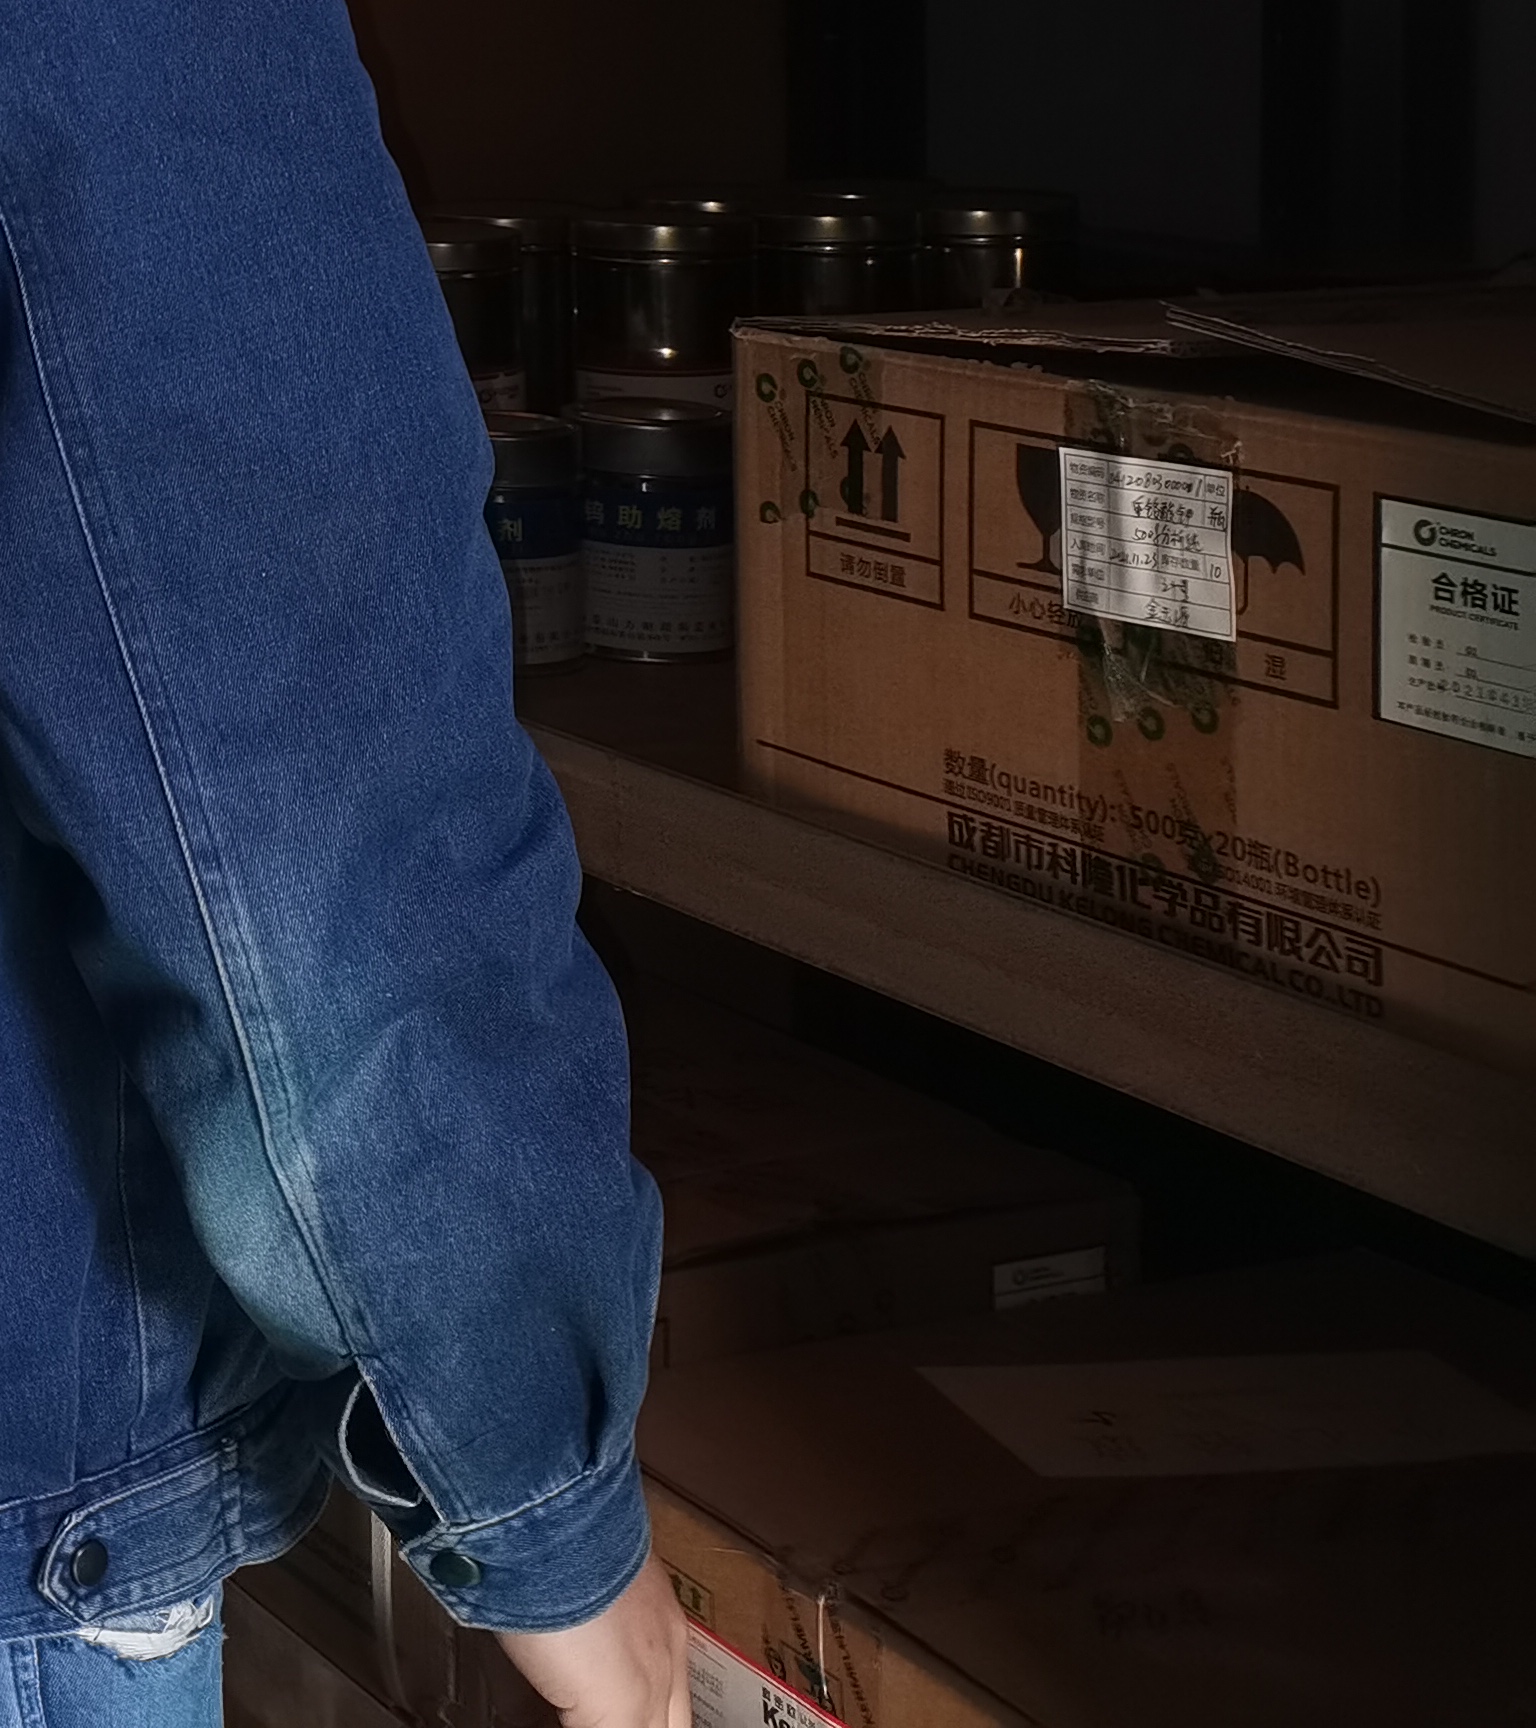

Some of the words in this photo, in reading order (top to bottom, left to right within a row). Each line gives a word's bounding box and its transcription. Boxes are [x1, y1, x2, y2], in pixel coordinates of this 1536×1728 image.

[1438, 537, 1498, 558] CHEMICALS
[1439, 525, 1476, 541] CHRON
[839, 552, 907, 588] 请勿倒置
[1431, 572, 1520, 617] 合格证
[947, 852, 1054, 906] CHENGDU
[947, 811, 1384, 987] 成都市科隆化学品有限公司
